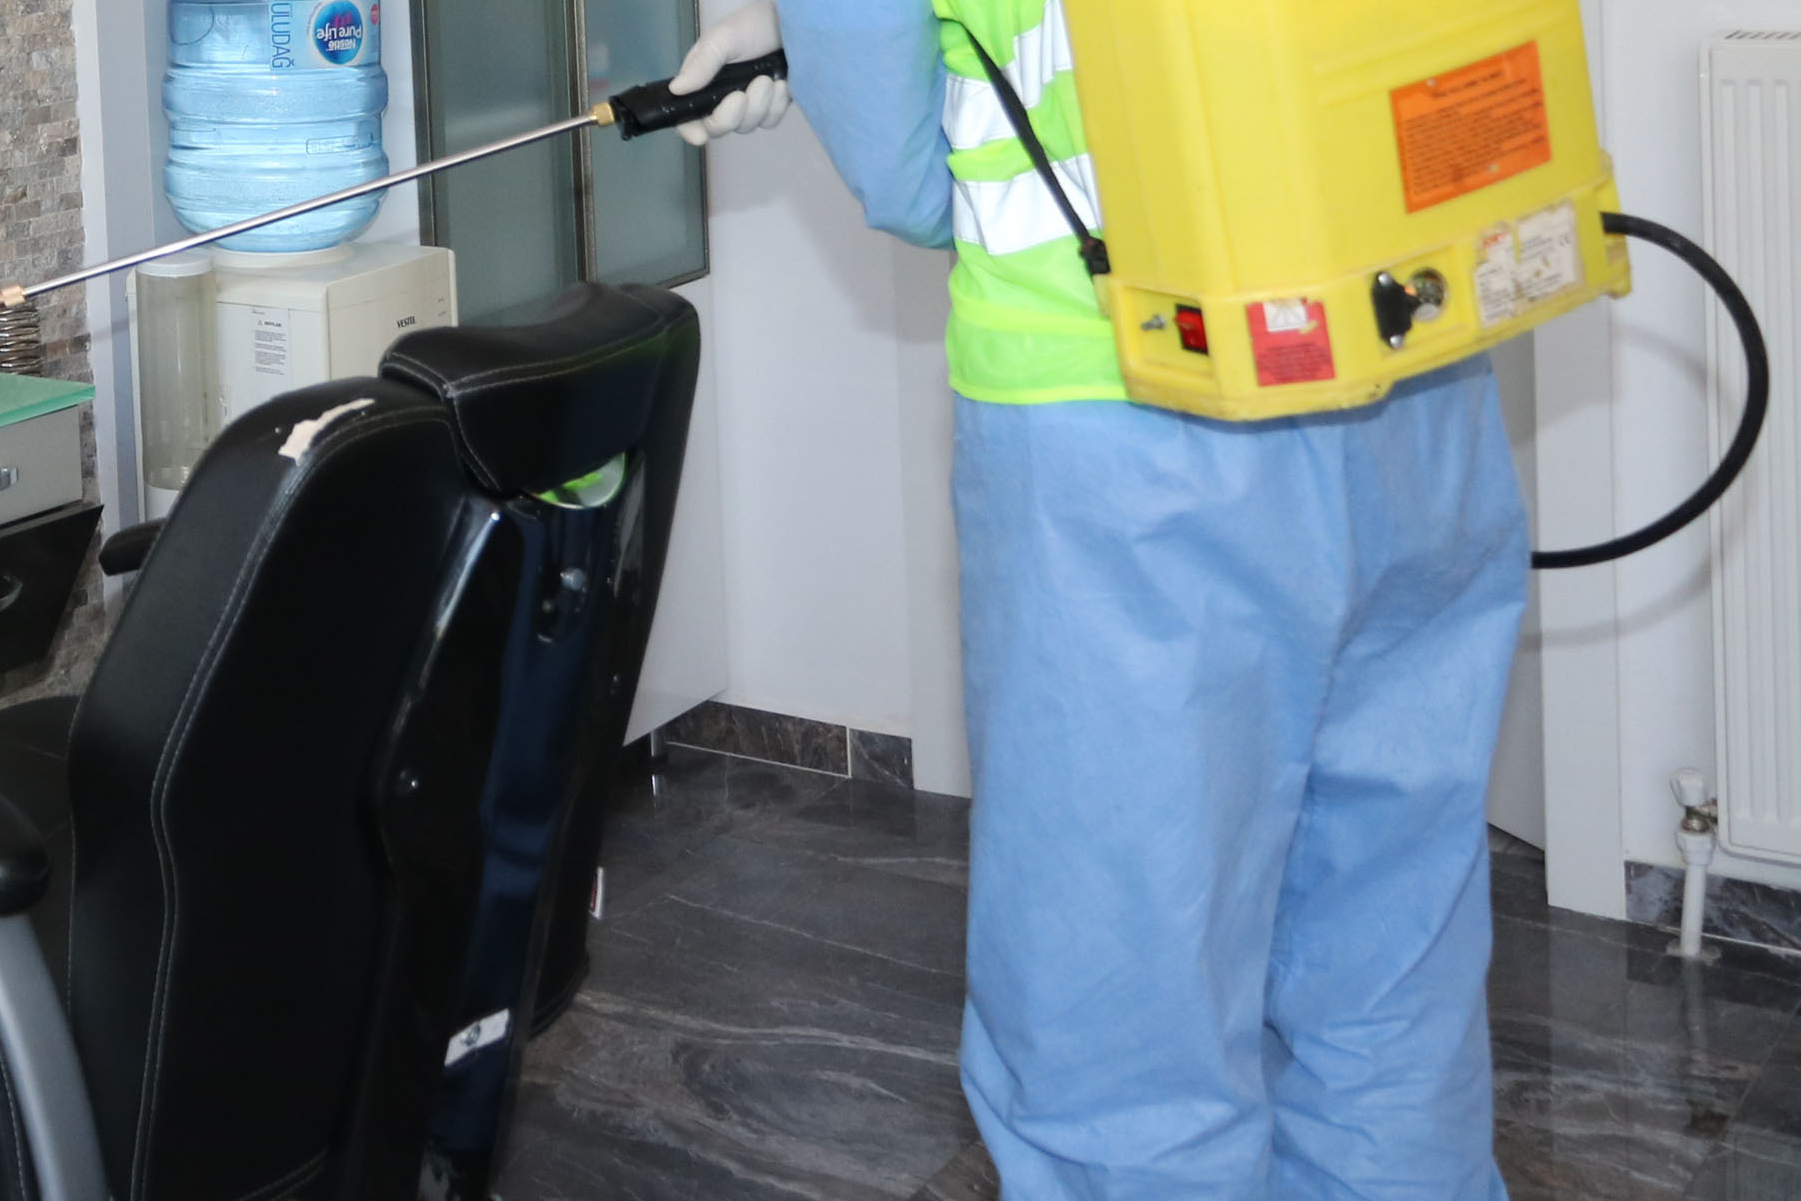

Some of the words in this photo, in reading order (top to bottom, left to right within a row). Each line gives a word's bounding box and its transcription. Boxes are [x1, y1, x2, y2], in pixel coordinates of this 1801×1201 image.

[271, 2, 295, 69] ULUDAĞ
[316, 22, 338, 42] Life
[338, 25, 362, 40] Pure
